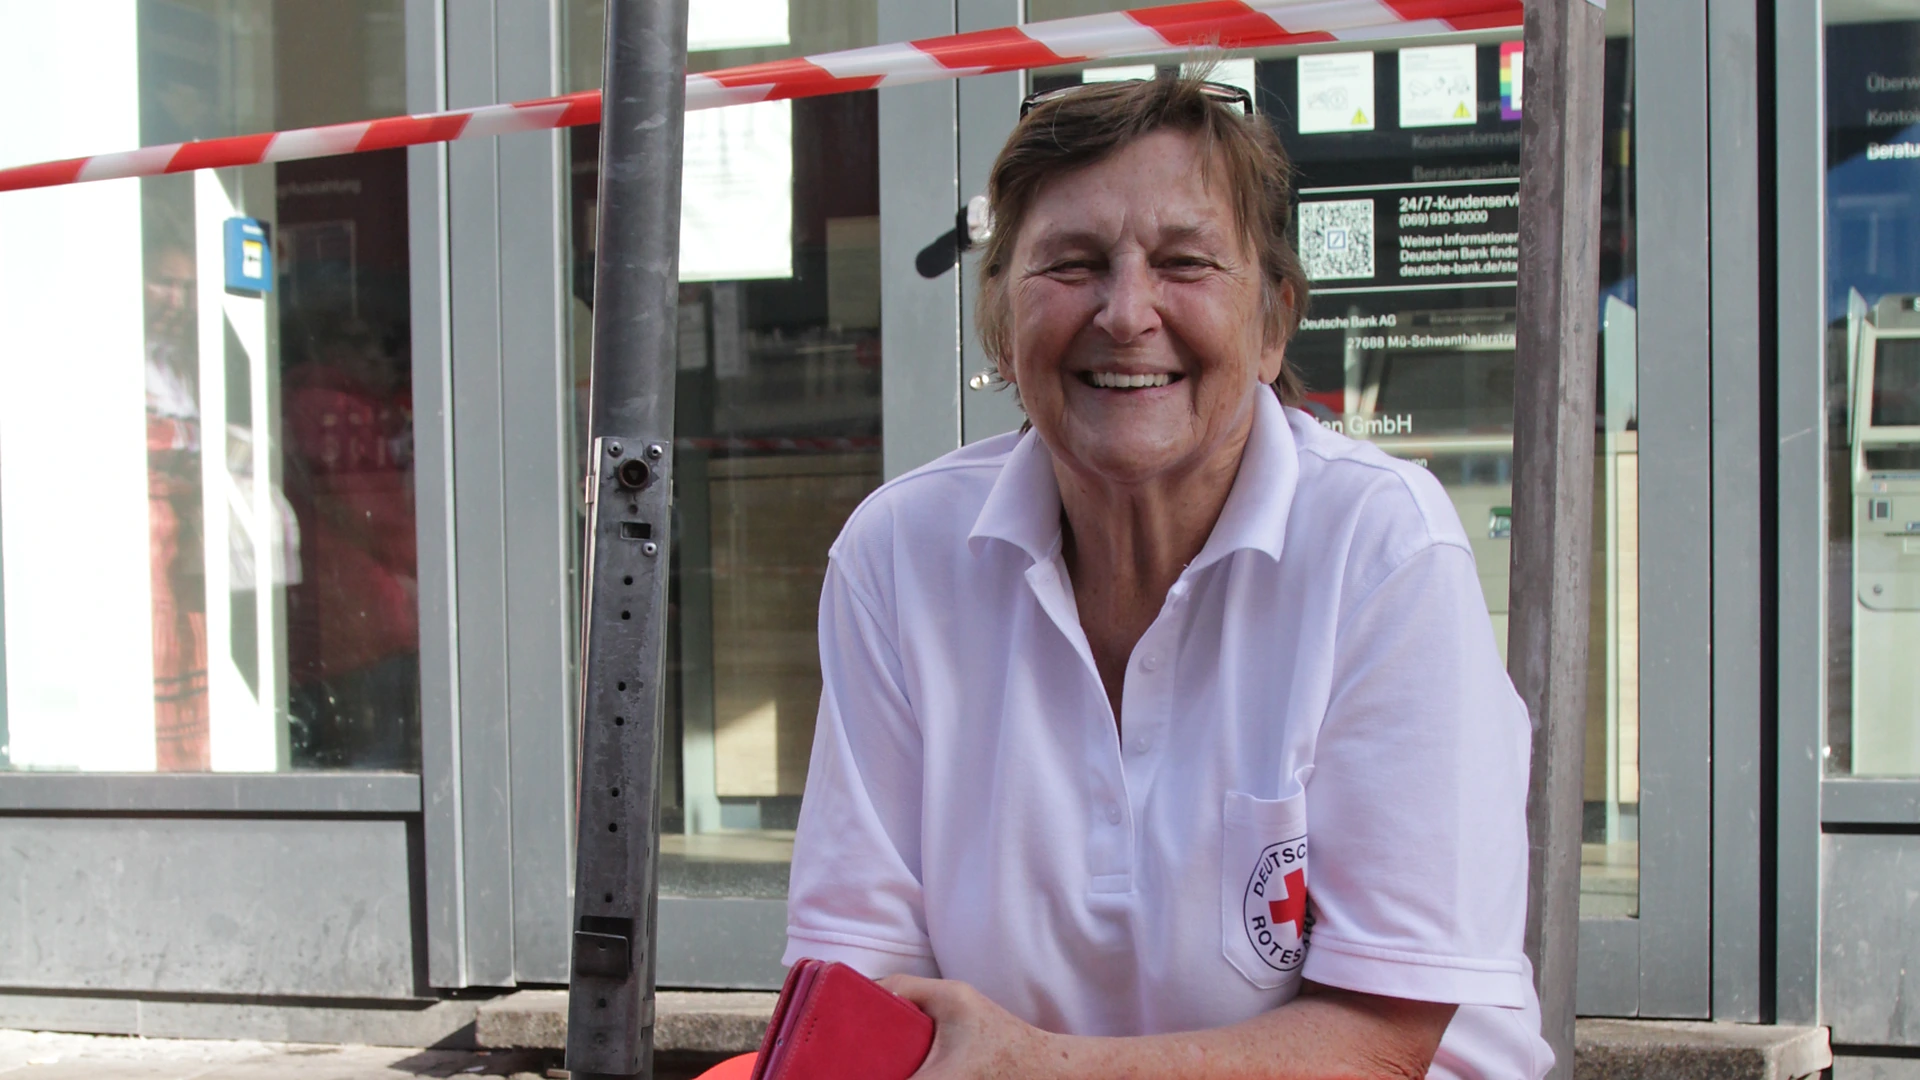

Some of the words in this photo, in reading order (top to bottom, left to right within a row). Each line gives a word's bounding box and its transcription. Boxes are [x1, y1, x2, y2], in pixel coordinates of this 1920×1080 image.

[1399, 213, 1429, 229] (069)
[1429, 210, 1488, 226] 910-10000
[1399, 234, 1443, 249] Weitere
[1400, 248, 1459, 263] Deutschen
[1460, 246, 1489, 261] Bank
[1299, 316, 1350, 331] Deutsche
[1350, 314, 1378, 329] Bank
[1379, 313, 1397, 327] AG
[1349, 414, 1412, 435] GmbH
[1252, 915, 1302, 964] ROTES
